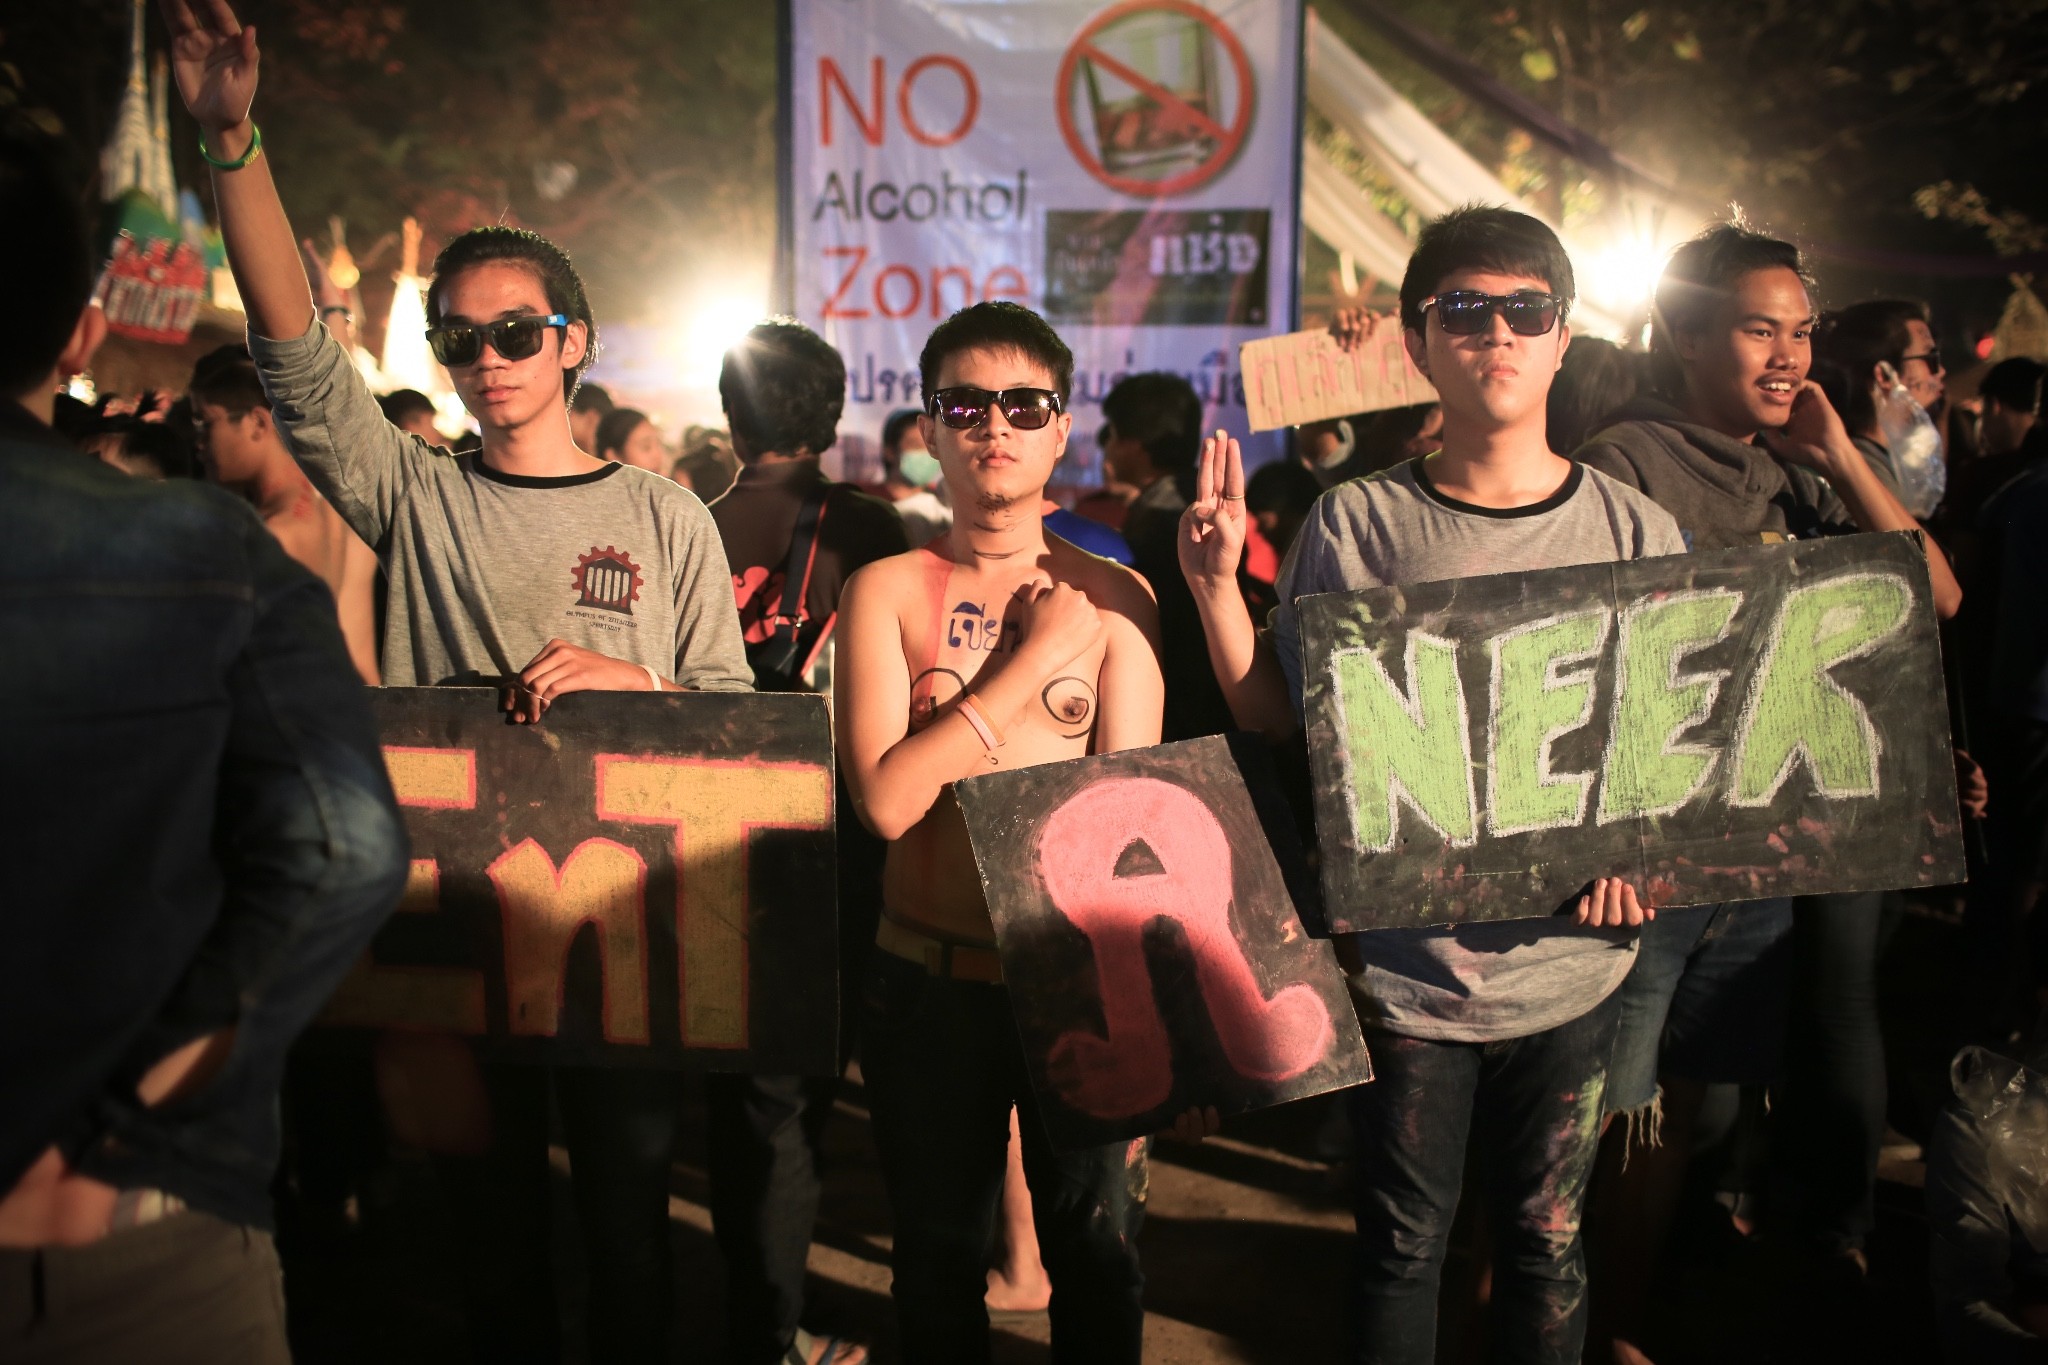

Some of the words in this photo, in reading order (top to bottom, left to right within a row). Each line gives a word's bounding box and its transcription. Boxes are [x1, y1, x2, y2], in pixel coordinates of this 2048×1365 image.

[817, 54, 980, 147] NO
[812, 169, 1029, 223] Alcohol
[820, 246, 1030, 320] Zone
[1329, 572, 1914, 853] NEER
